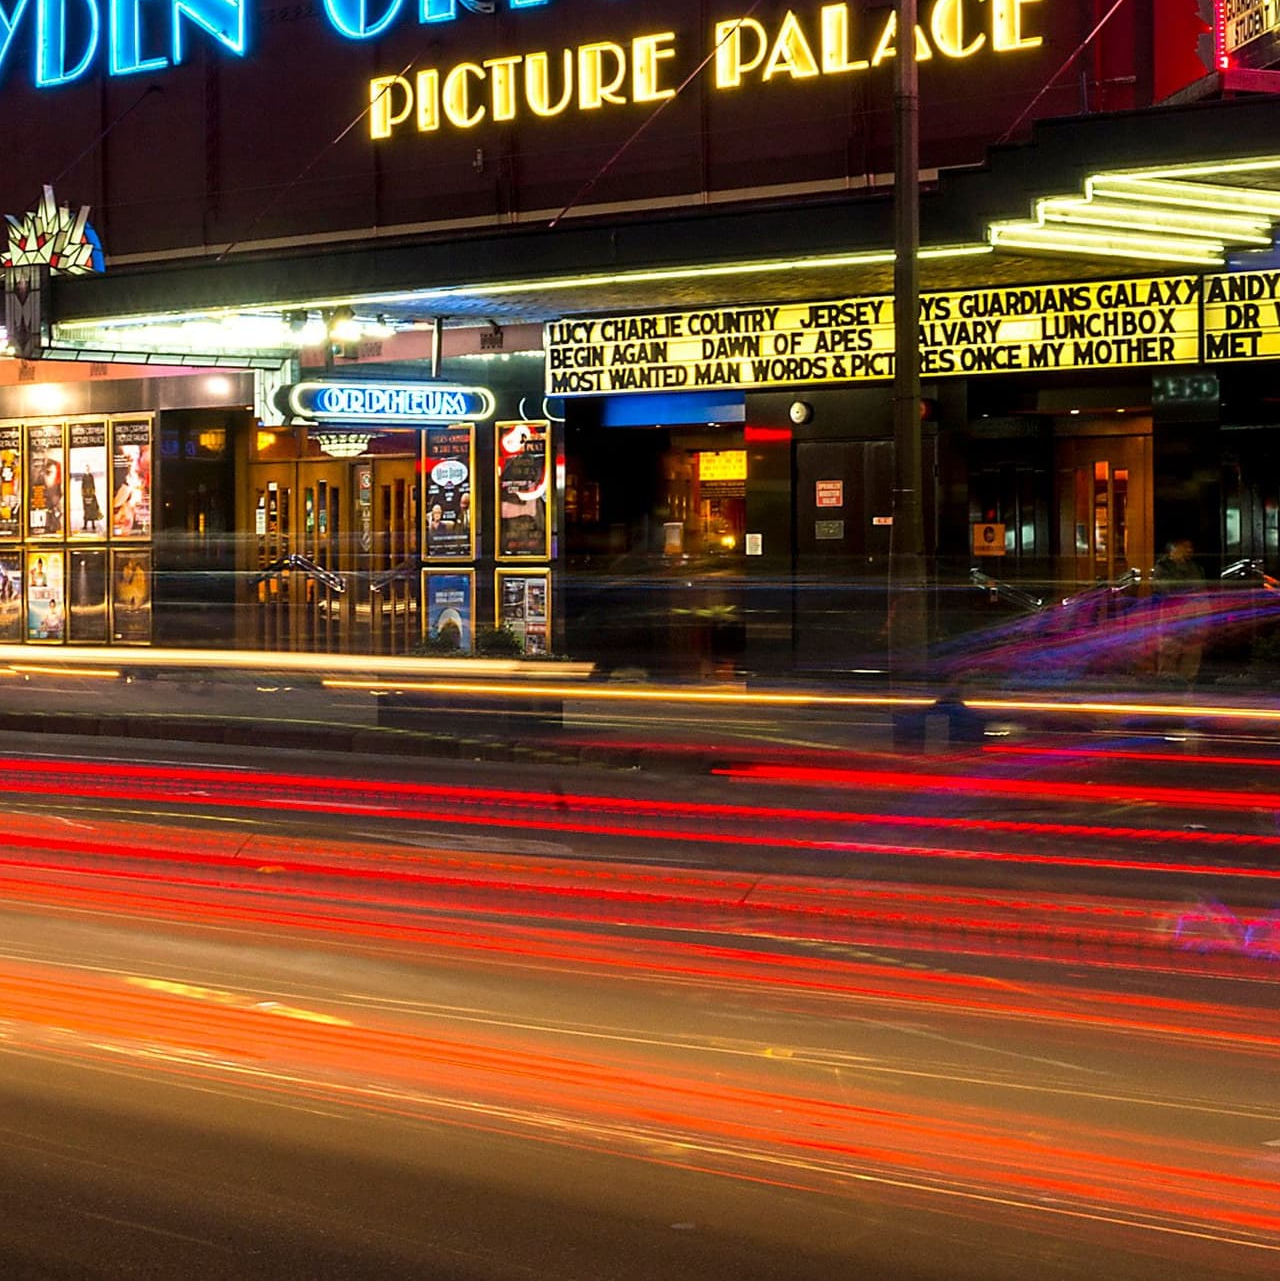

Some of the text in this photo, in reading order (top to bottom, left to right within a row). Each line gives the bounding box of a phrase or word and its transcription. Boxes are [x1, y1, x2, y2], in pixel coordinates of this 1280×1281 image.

[368, 32, 677, 141] PICTURE
[549, 322, 596, 346] LUCY
[601, 314, 682, 342] CHARLIE
[688, 307, 779, 336] COUNTRY
[800, 301, 884, 328] JERSEY
[959, 286, 1091, 318] GUARDIANS
[1097, 279, 1200, 309] GALAXY
[550, 308, 1176, 369] BEGIN AGAIN DAWN OF APES ALVARY LUNCHBOX
[1226, 304, 1260, 330] DR
[552, 370, 603, 394] MOST
[608, 365, 687, 390] WANTED
[695, 363, 740, 385] MAN
[751, 356, 827, 382] WORDS
[832, 355, 846, 377] &
[960, 345, 1022, 371] ONCE
[1028, 342, 1066, 368] MY
[1074, 336, 1175, 365] MOTHER
[1207, 331, 1263, 360] MET
[323, 387, 467, 416] ORPHEUM
